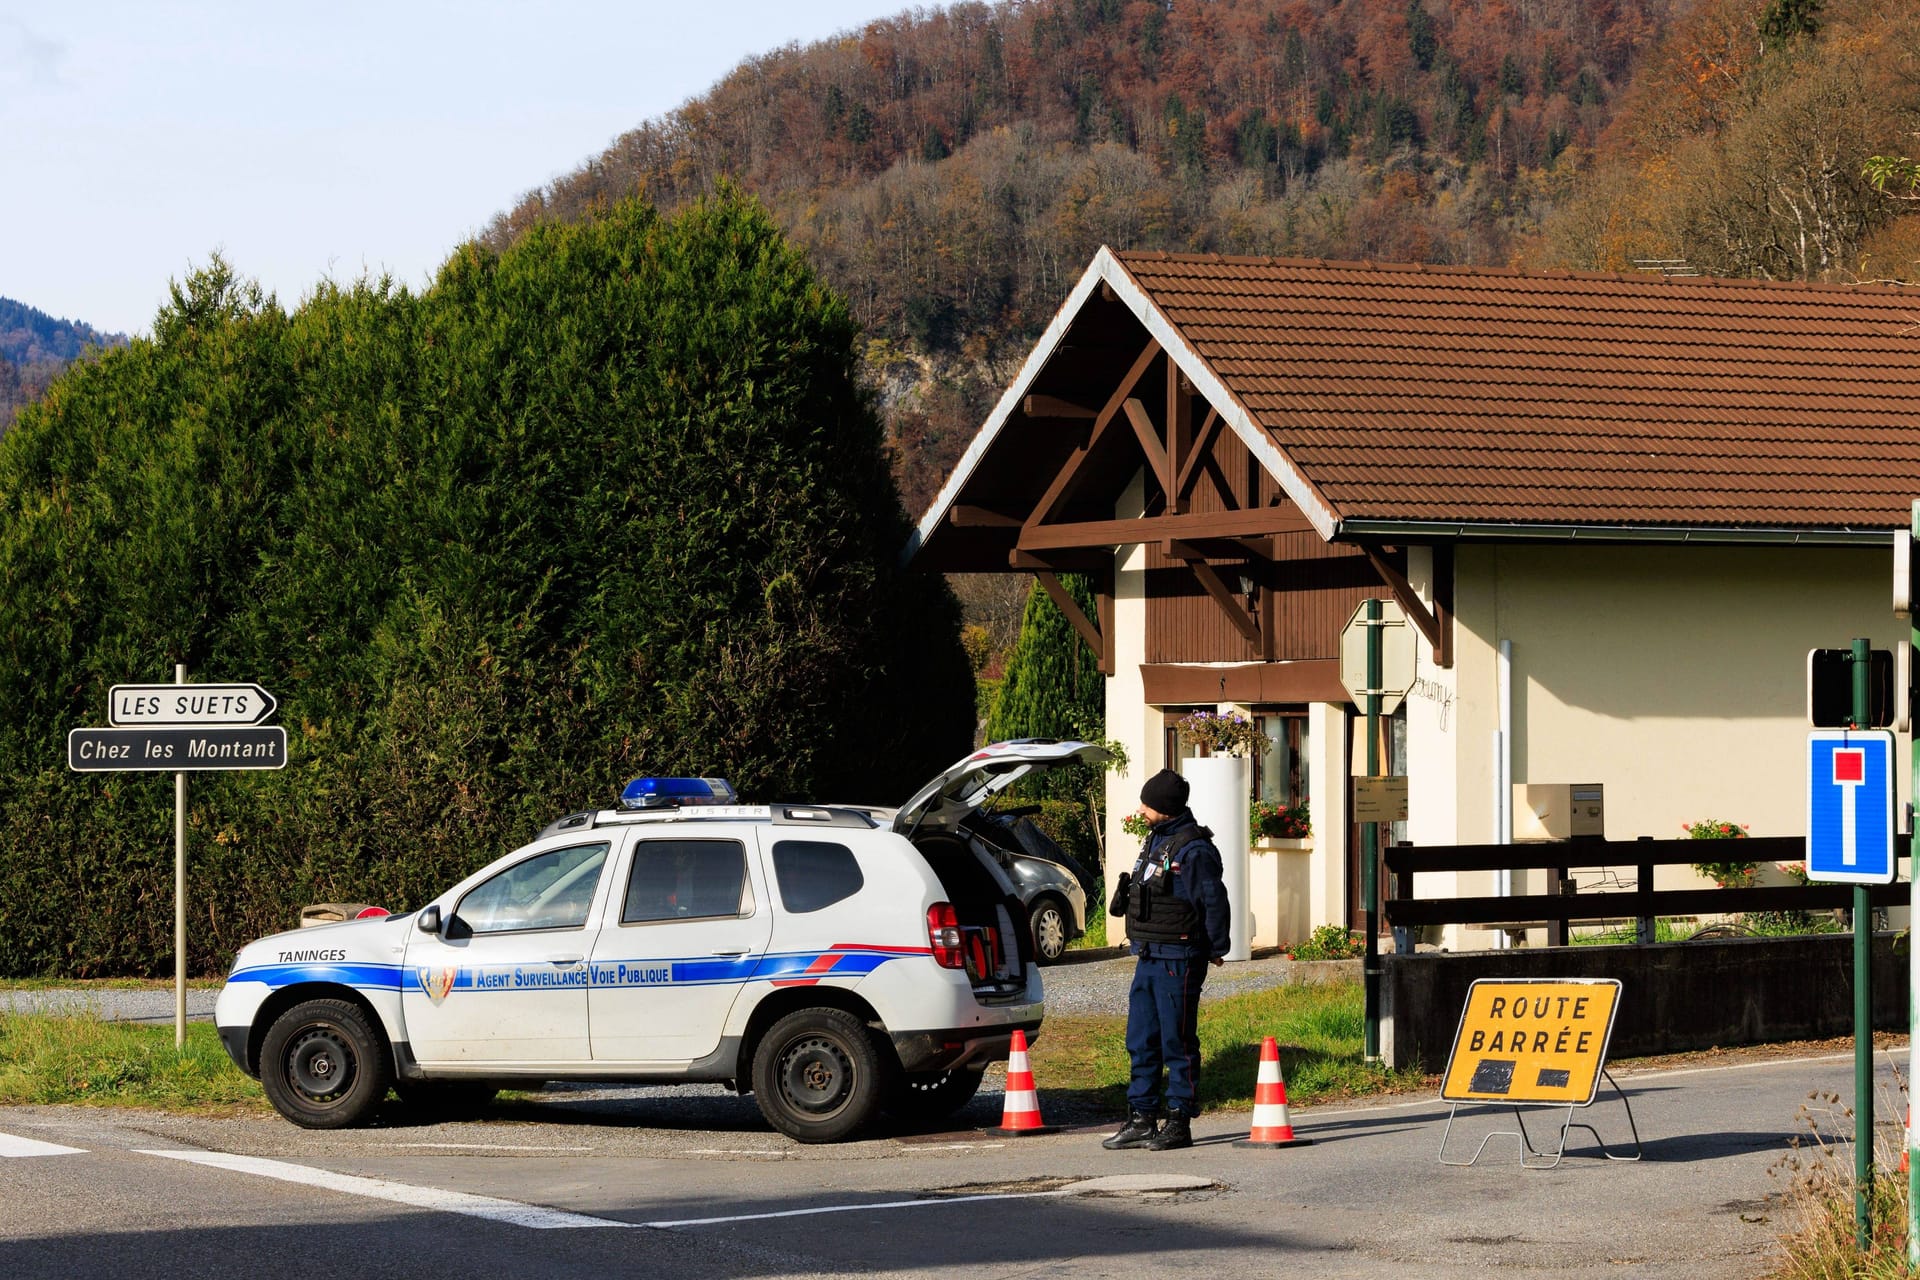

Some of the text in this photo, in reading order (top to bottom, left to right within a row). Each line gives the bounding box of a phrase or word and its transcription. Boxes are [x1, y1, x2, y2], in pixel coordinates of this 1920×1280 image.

[122, 696, 248, 715] LES SUETS
[79, 739, 275, 759] Chez les Montant
[278, 949, 346, 962] TANINGES
[477, 969, 510, 988] AGENT
[590, 965, 615, 985] VOIE
[618, 964, 669, 984] PUBLIQUE
[1489, 997, 1589, 1019] ROUTE
[1469, 1026, 1592, 1053] BARRÉE
